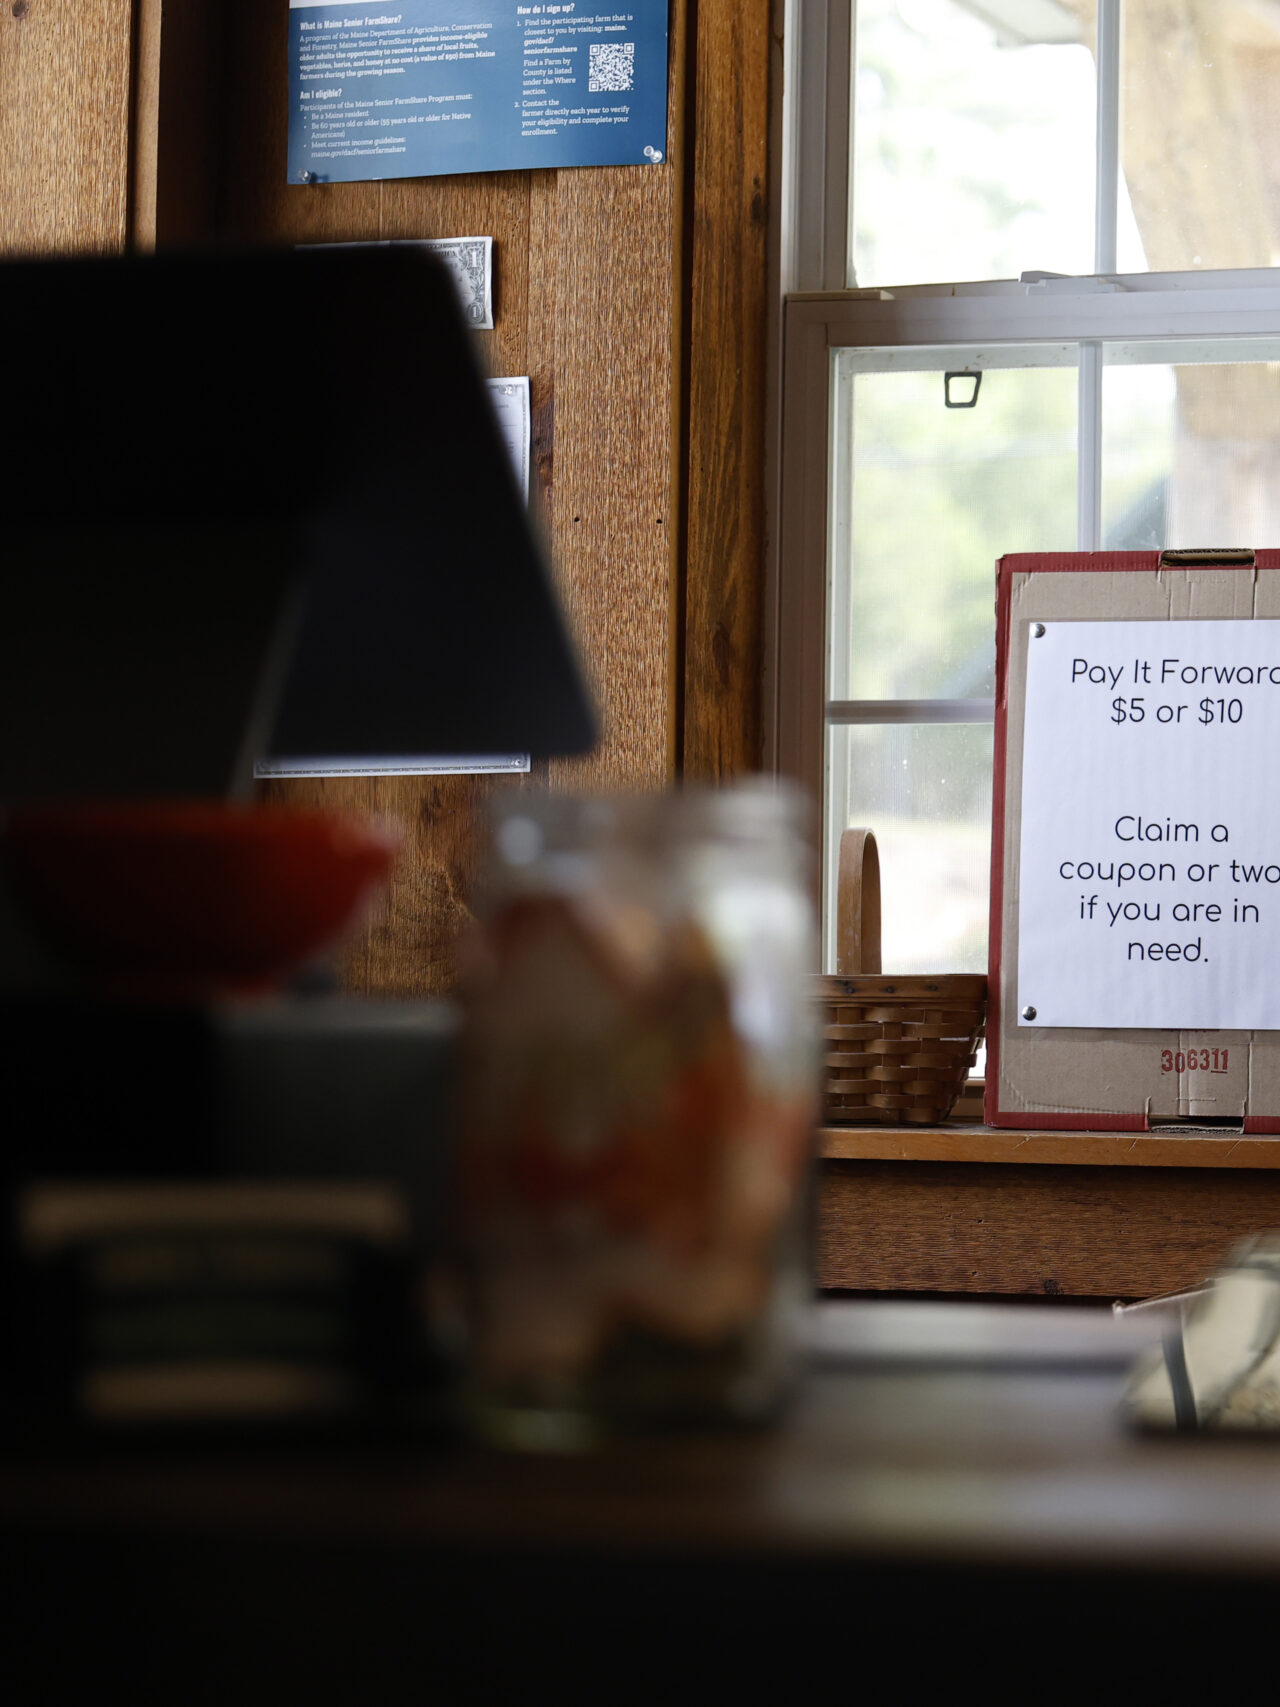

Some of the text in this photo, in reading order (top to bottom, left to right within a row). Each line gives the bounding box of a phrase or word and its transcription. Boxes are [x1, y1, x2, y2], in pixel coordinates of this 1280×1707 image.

[517, 4, 575, 15] How do I sign up?
[300, 15, 402, 30] What is Maine Senior FarmShare?
[552, 16, 594, 26] participating
[595, 15, 611, 23] farm
[612, 14, 626, 22] that
[562, 58, 571, 66] by
[523, 69, 546, 78] County
[300, 88, 342, 100] Am I eligible?
[522, 99, 547, 107] Contact
[549, 98, 560, 106] the
[1073, 659, 1124, 690] Pay
[1134, 660, 1152, 684] It
[1111, 697, 1243, 725] $5 or $10
[1115, 816, 1229, 842] Claim a
[1060, 862, 1176, 888] coupon
[1187, 863, 1220, 882] or
[1080, 894, 1259, 928] if you are in
[1127, 937, 1209, 962] need.
[1161, 1048, 1229, 1074] 306311
